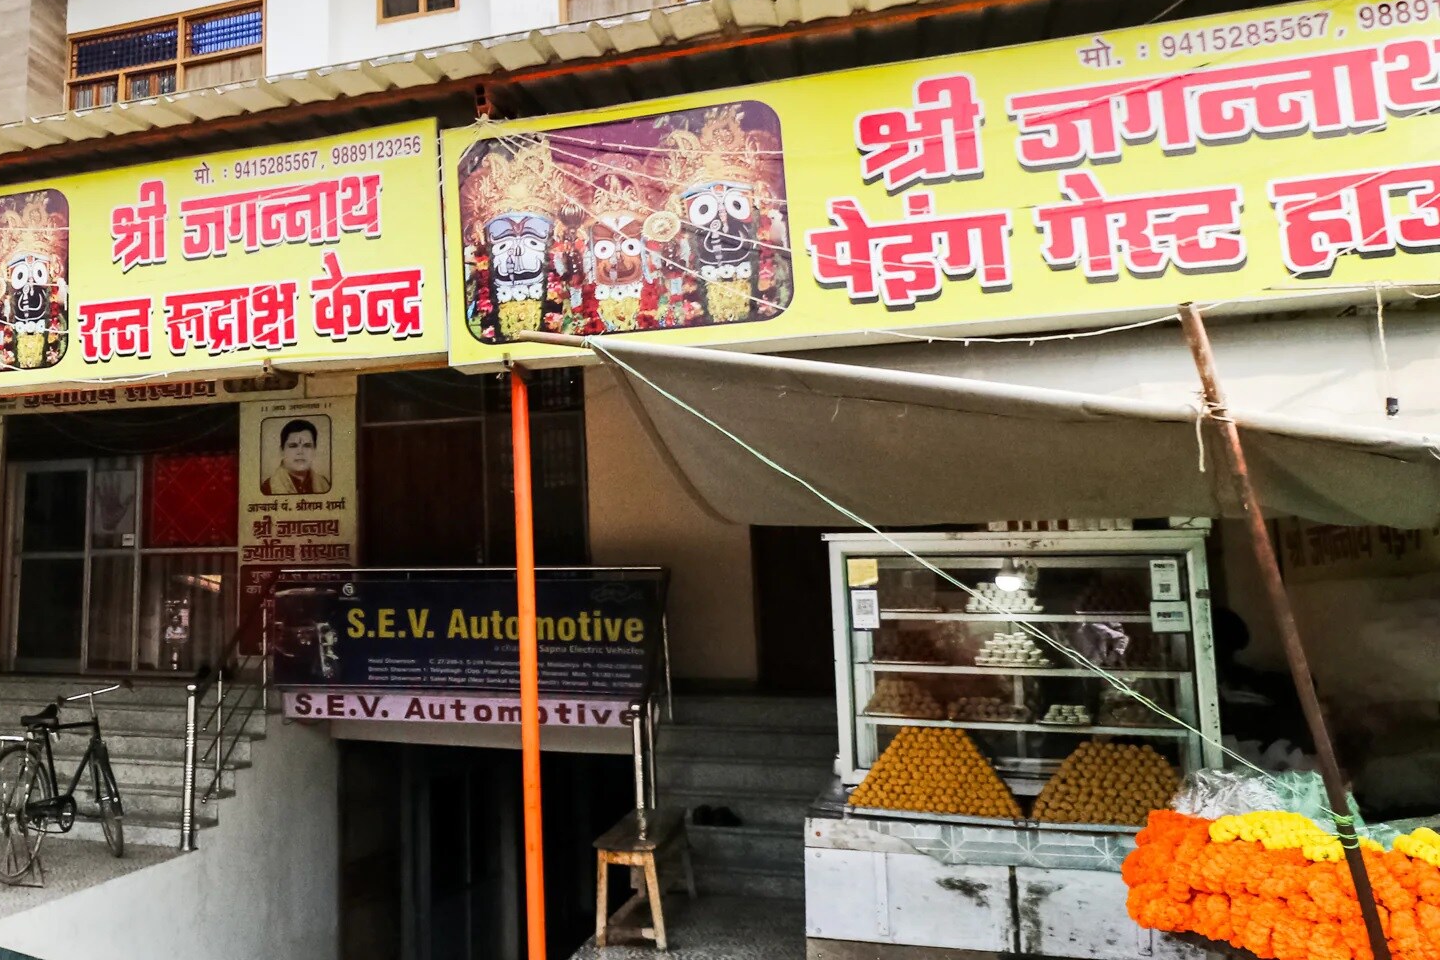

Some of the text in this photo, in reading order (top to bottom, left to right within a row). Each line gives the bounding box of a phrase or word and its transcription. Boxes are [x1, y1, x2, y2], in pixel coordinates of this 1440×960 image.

[234, 150, 326, 180] 9415285567,
[331, 135, 422, 165] 9889123256
[857, 74, 981, 192] श्री
[111, 173, 382, 271] श्री जगन्नाथ
[1036, 171, 1243, 279] गेस्ट
[78, 297, 153, 361] रत्न
[311, 250, 423, 338] केन्द्र
[346, 607, 435, 640] S.E.V.
[294, 693, 390, 720] S.E.V.
